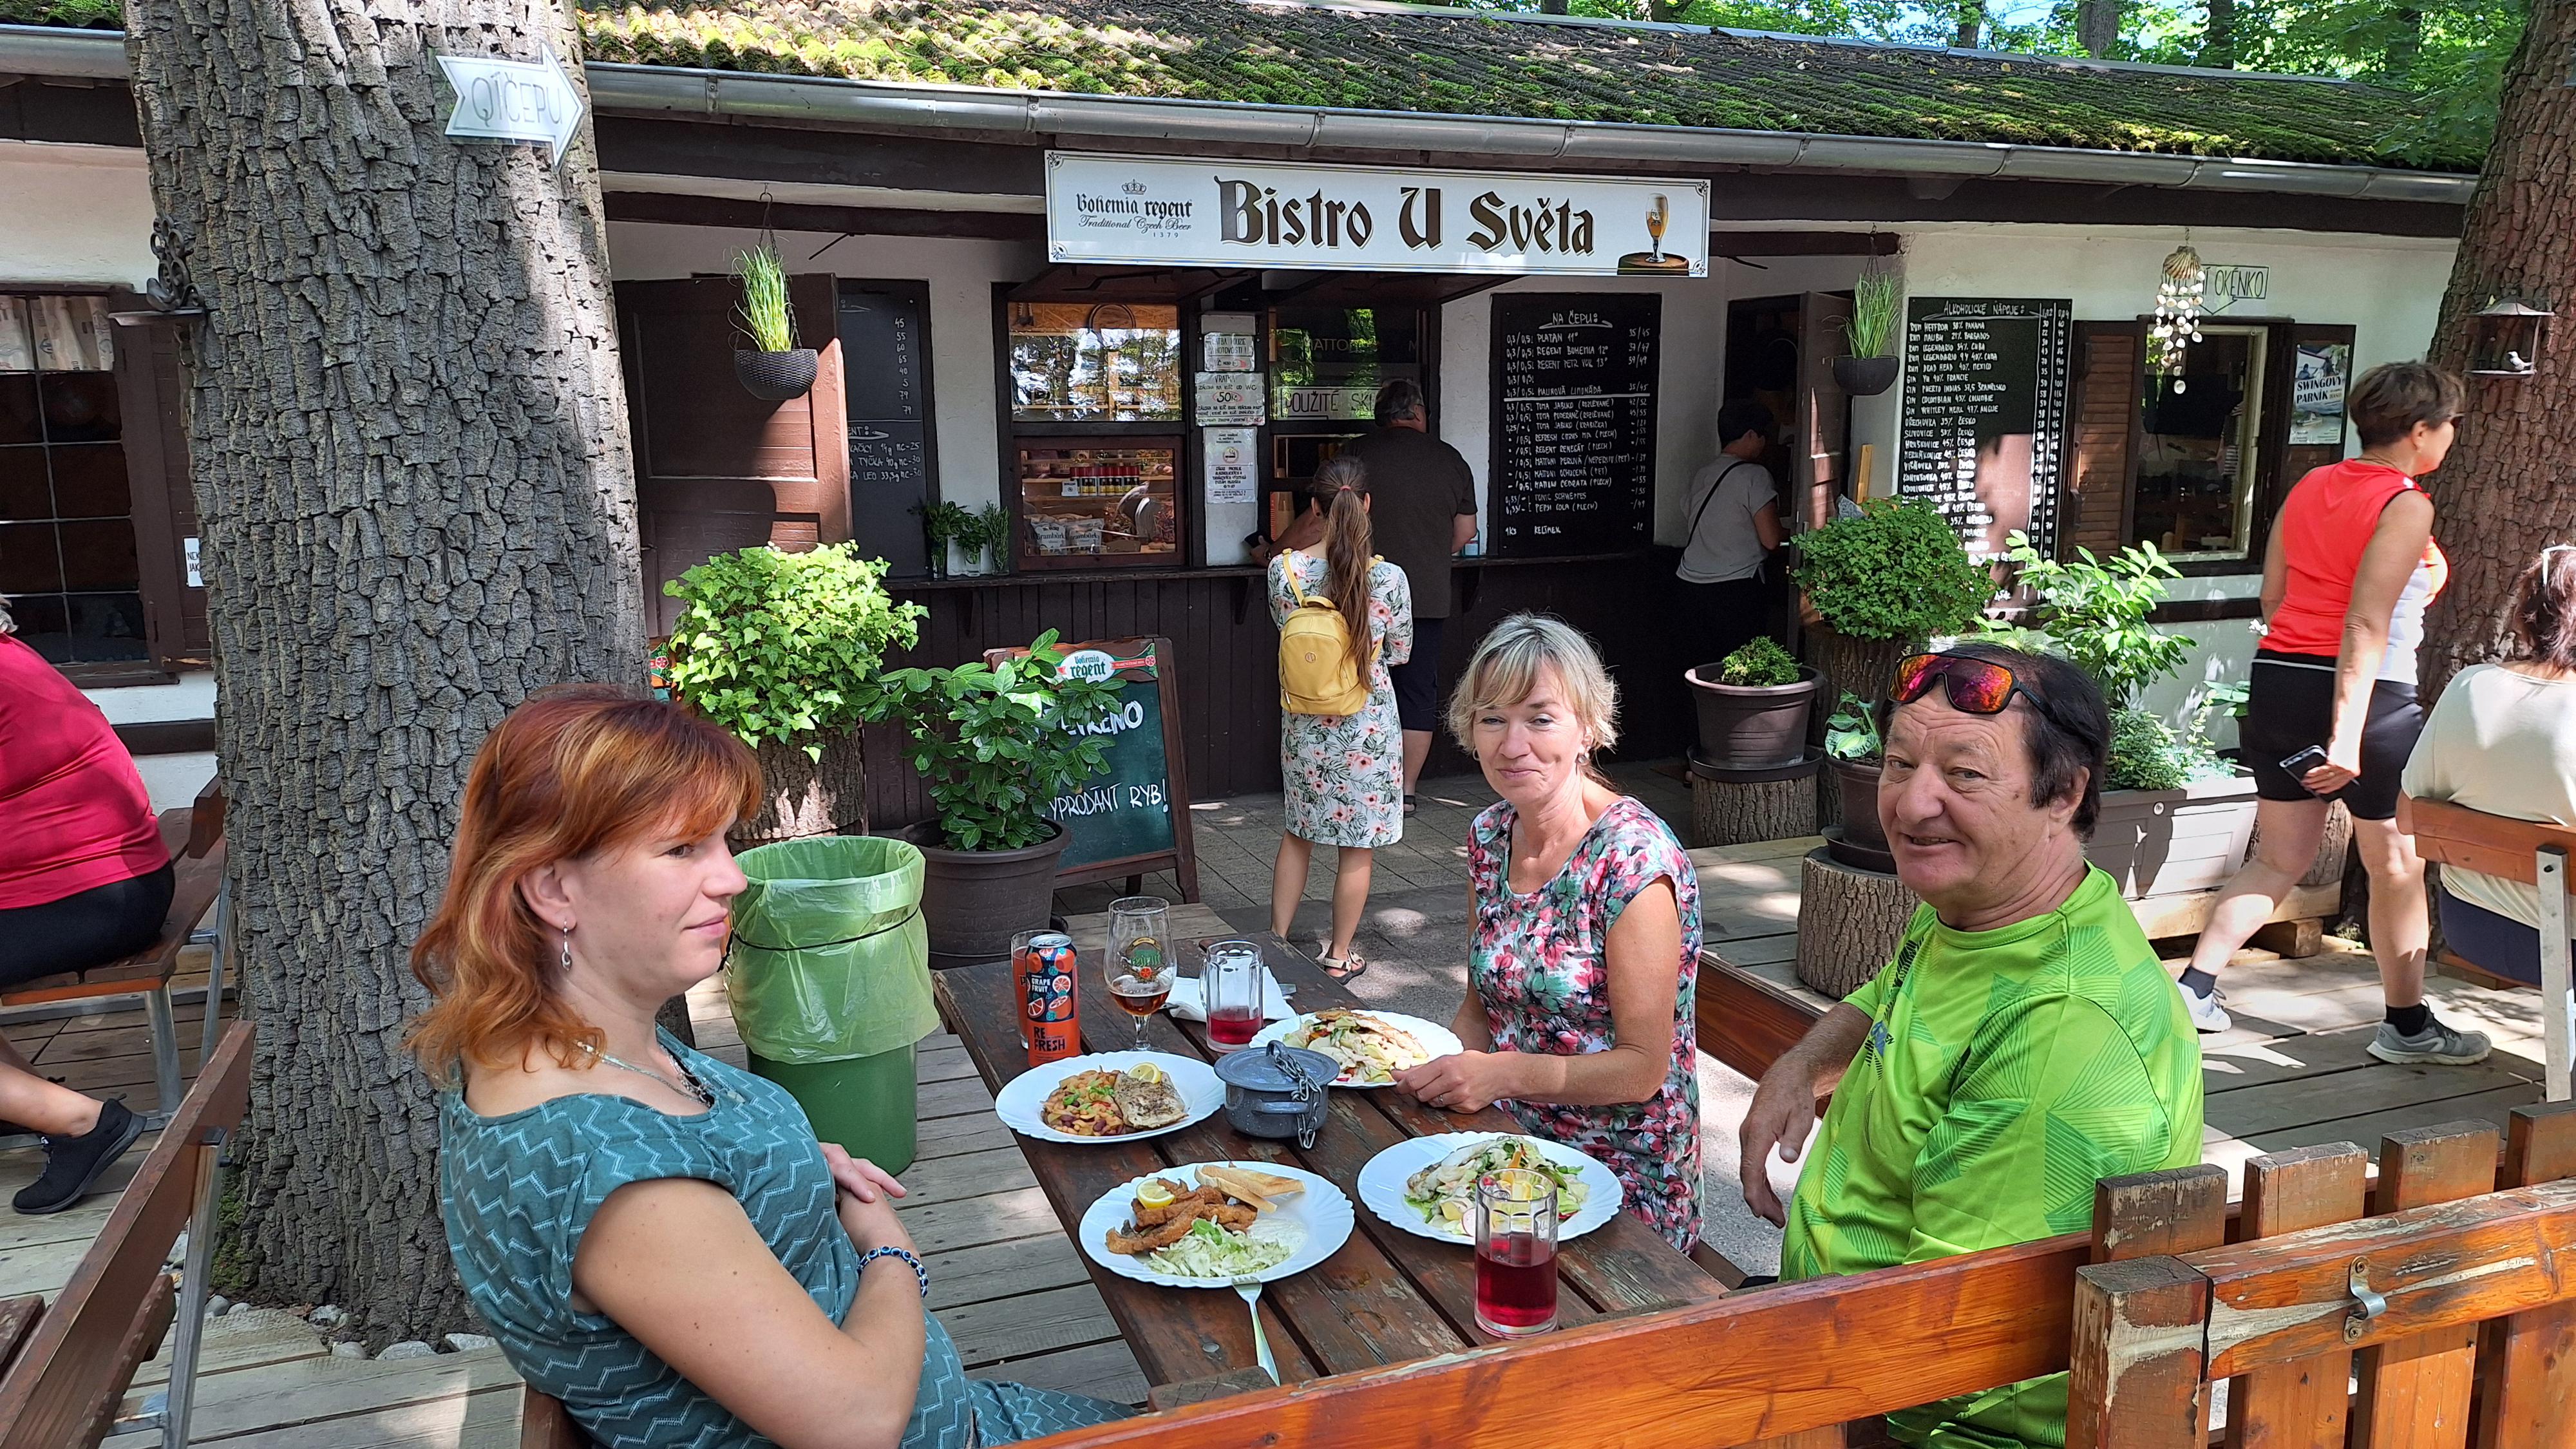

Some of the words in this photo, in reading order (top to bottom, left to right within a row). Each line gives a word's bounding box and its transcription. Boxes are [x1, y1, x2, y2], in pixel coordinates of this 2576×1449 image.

[1076, 193, 1139, 214] Bohemia
[1144, 199, 1193, 220] regent
[1214, 175, 1373, 250] Bistro
[1398, 186, 1443, 251] U
[1466, 191, 1595, 256] Světa
[1079, 214, 1132, 228] Traditional
[1134, 216, 1162, 234] Czech
[1165, 218, 1192, 231] Beer
[2215, 267, 2264, 297] OKÉNKO
[895, 317, 905, 328] 45
[1553, 312, 1564, 324] NA
[896, 332, 906, 341] 55
[1537, 334, 1562, 343] PLATAN
[896, 343, 905, 352] 60
[1537, 346, 1562, 355] REGENT
[1567, 346, 1595, 355] BOHEMIA
[898, 355, 907, 363] 65
[2297, 389, 2328, 404] PARNÍK
[1921, 406, 1946, 414] WHITLEY
[1535, 457, 1556, 466] MATTONI
[863, 471, 876, 480] LEO
[1535, 504, 1552, 513] PEPSI
[1556, 503, 1569, 511] COLA
[1074, 655, 1099, 663] Bohemia
[1070, 662, 1106, 680] regent
[1042, 782, 1122, 821] YPRODÁNÍ
[1129, 778, 1168, 813] RYB!
[1034, 1027, 1046, 1039] RE
[1034, 1038, 1065, 1052] FRESH
